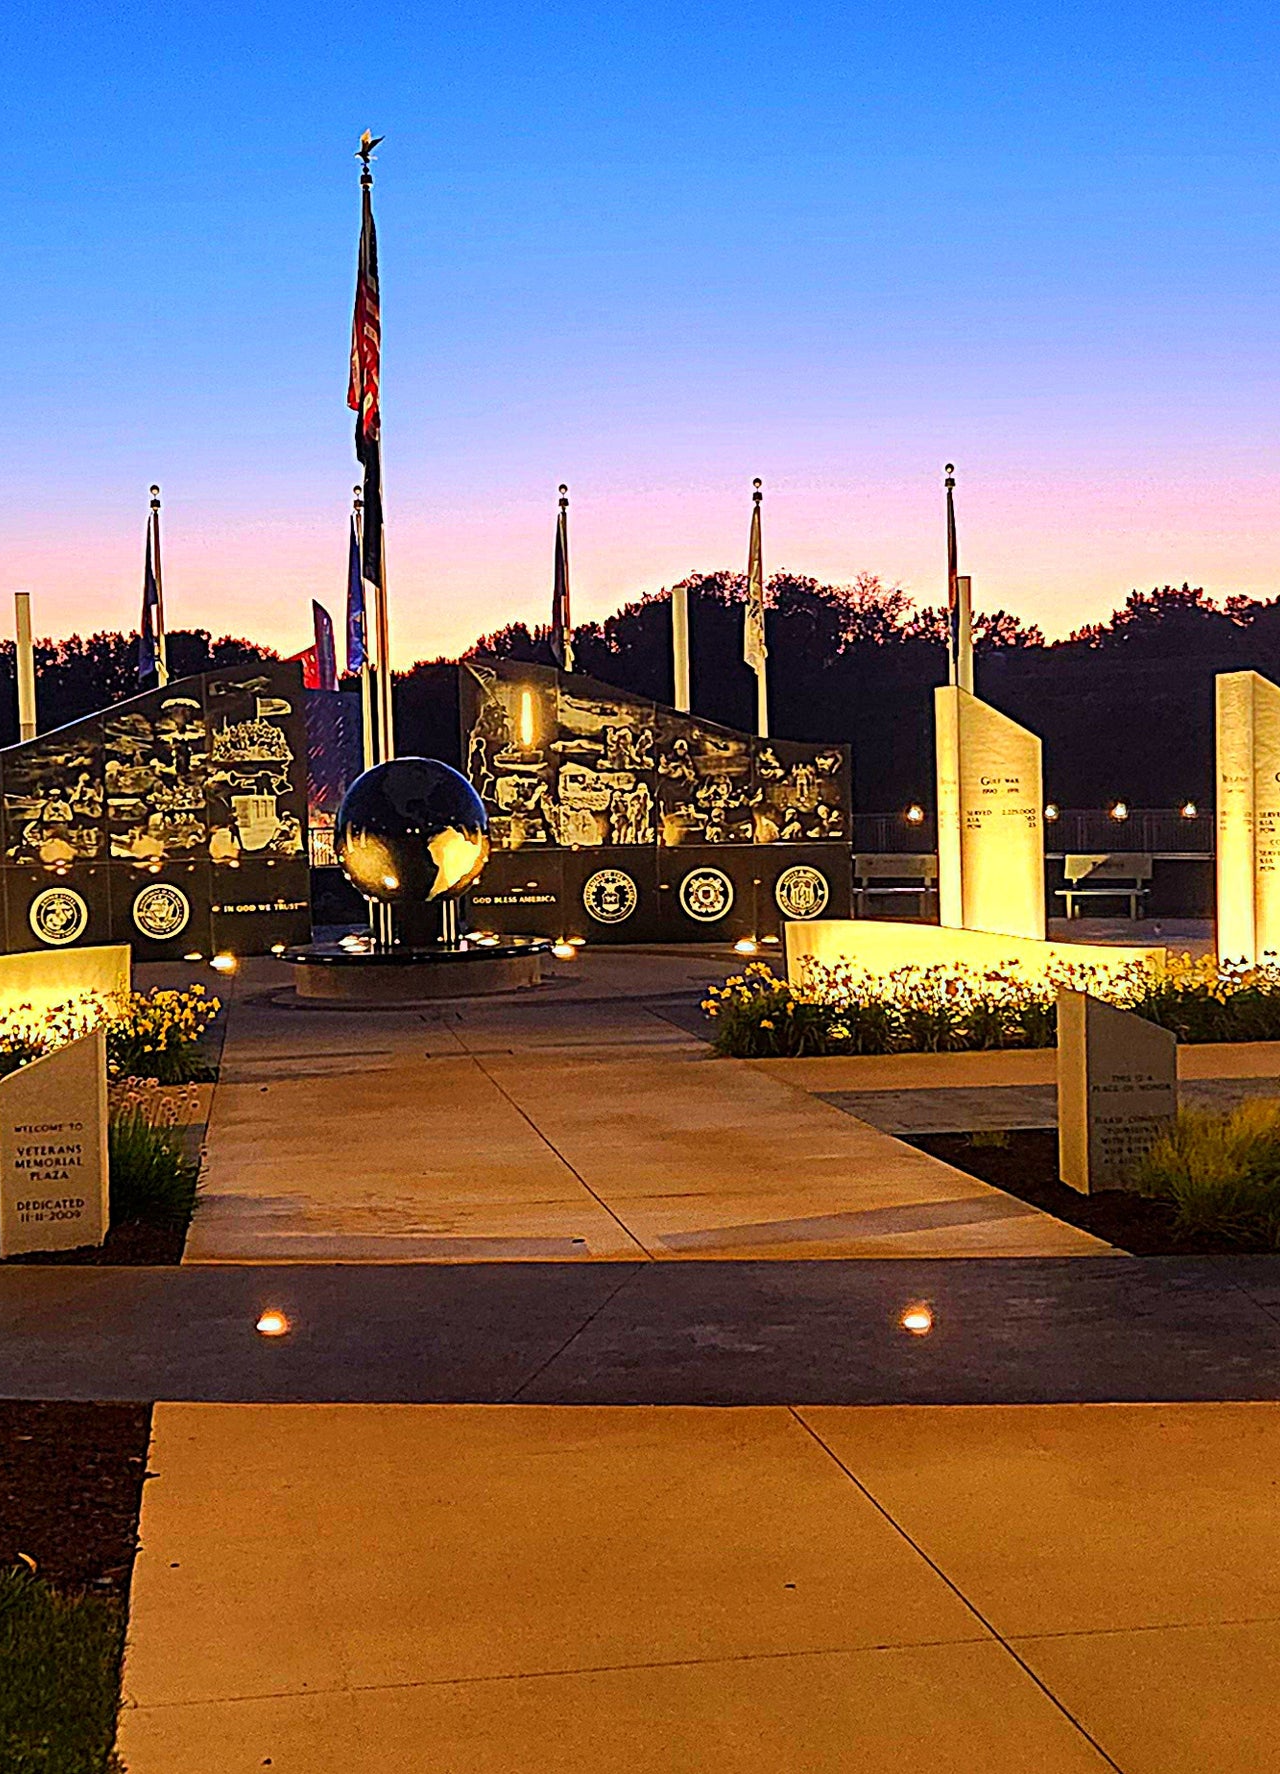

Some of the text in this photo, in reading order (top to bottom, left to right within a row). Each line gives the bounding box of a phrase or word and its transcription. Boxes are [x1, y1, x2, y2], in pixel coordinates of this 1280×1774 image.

[494, 896, 518, 904] BLESS
[519, 895, 556, 903] AMERICA
[223, 905, 234, 913] IN
[236, 904, 257, 912] GOD
[274, 902, 299, 911] TRUST
[14, 1122, 83, 1133] WELCOME TO
[17, 1144, 82, 1157] VETERANS
[15, 1156, 83, 1169] MEMORIAL
[30, 1170, 69, 1181] PLAZA
[16, 1198, 85, 1211] DEDICATED
